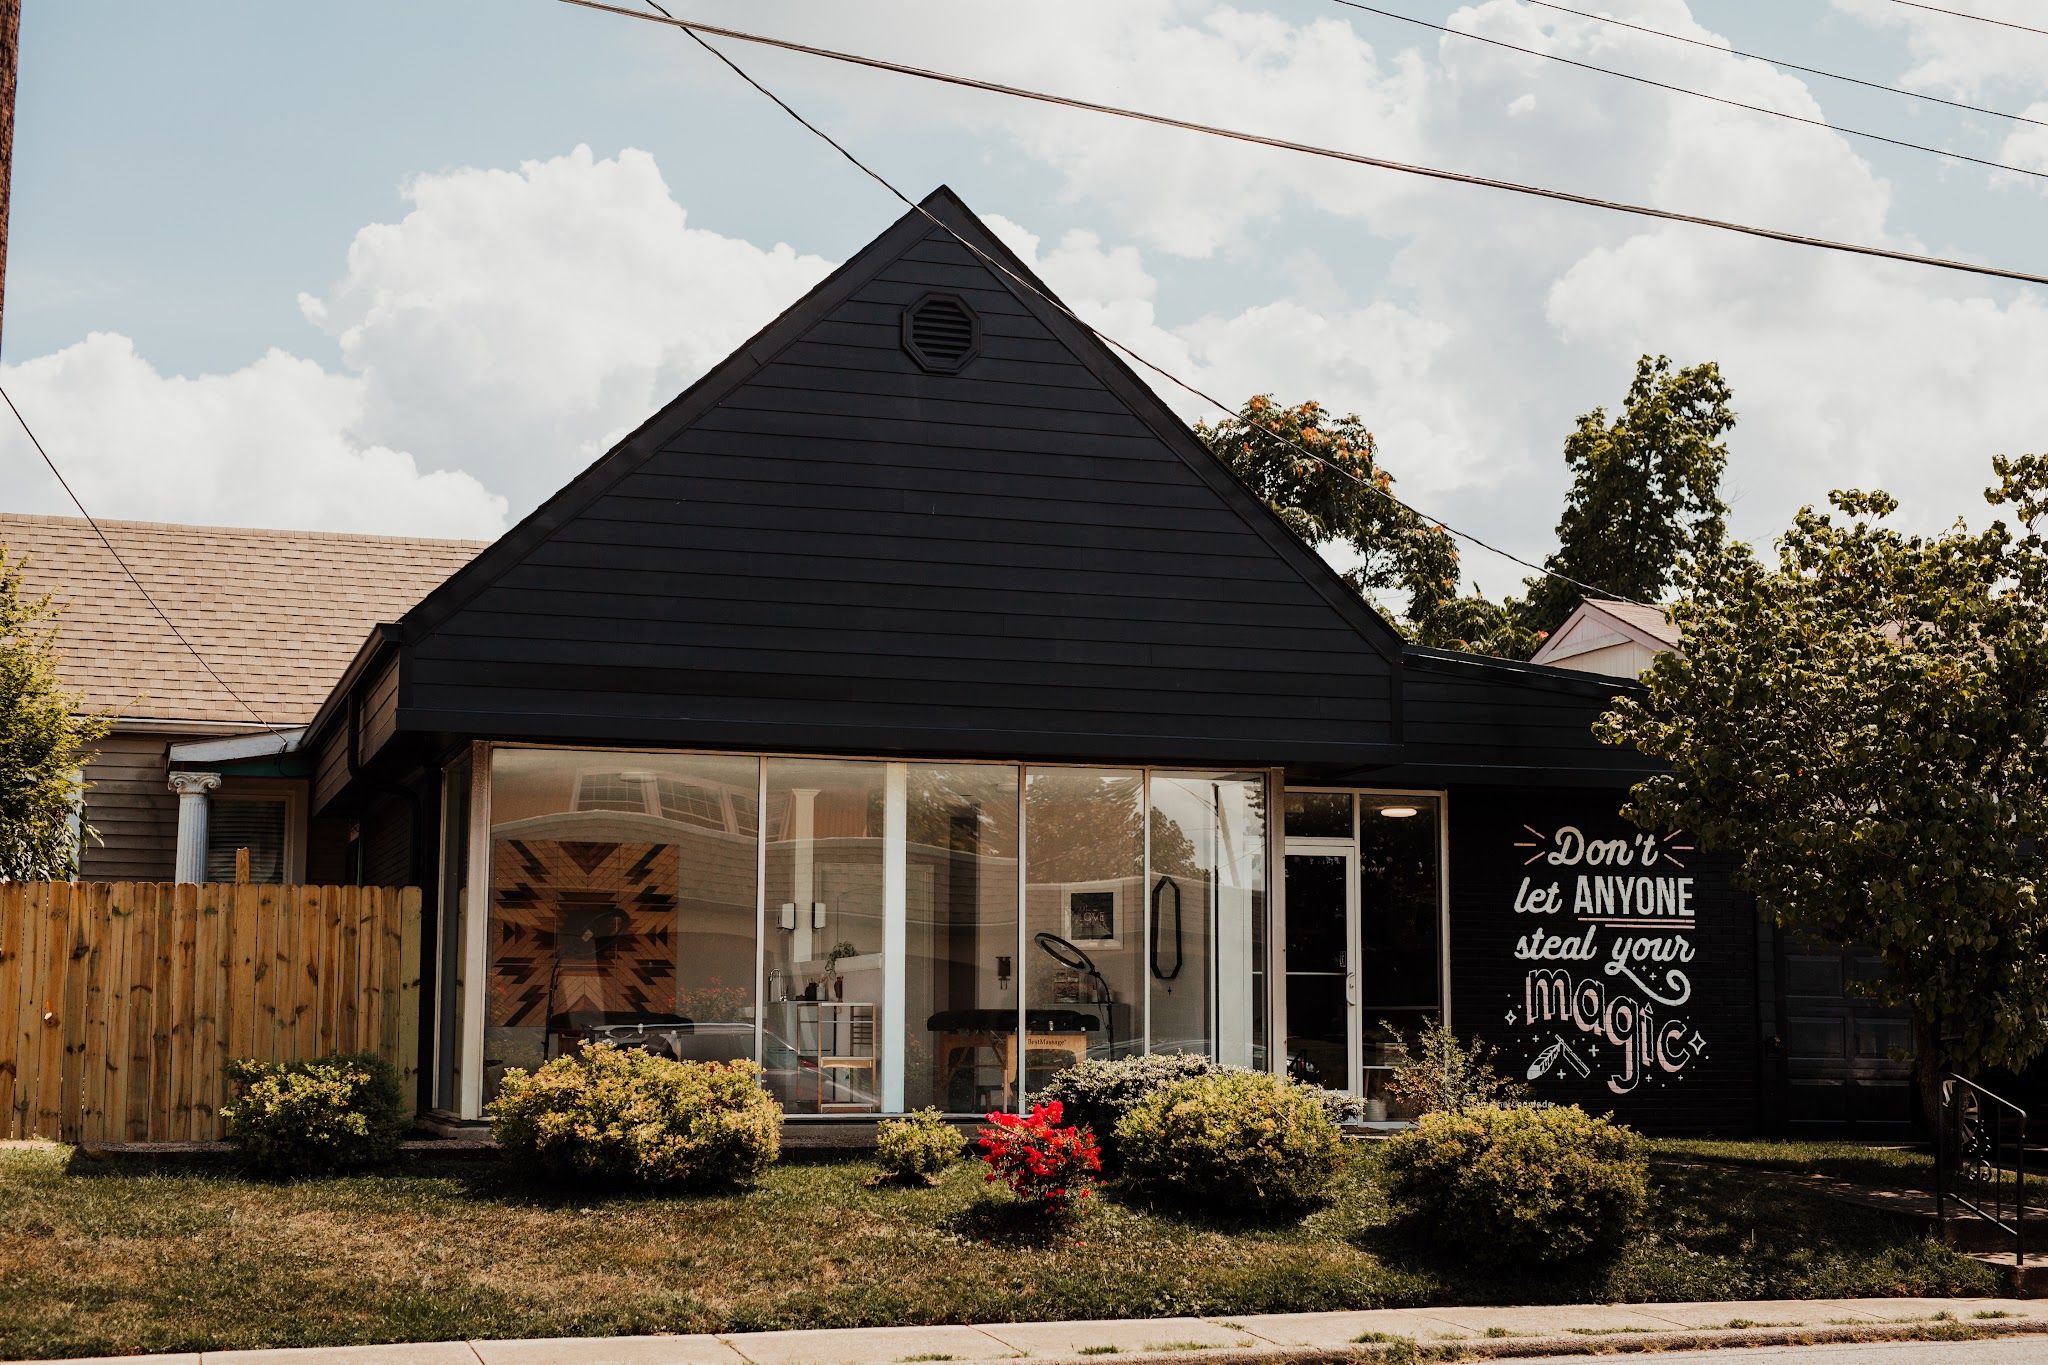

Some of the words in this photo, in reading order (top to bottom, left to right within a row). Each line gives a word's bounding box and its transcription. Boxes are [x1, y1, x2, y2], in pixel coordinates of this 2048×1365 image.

[1546, 825, 1659, 866] Don't
[1513, 876, 1563, 914] let
[1573, 875, 1695, 916] ANYONE
[1513, 924, 1598, 960] steal
[1603, 934, 1696, 1006] your
[1525, 968, 1690, 1094] magic
